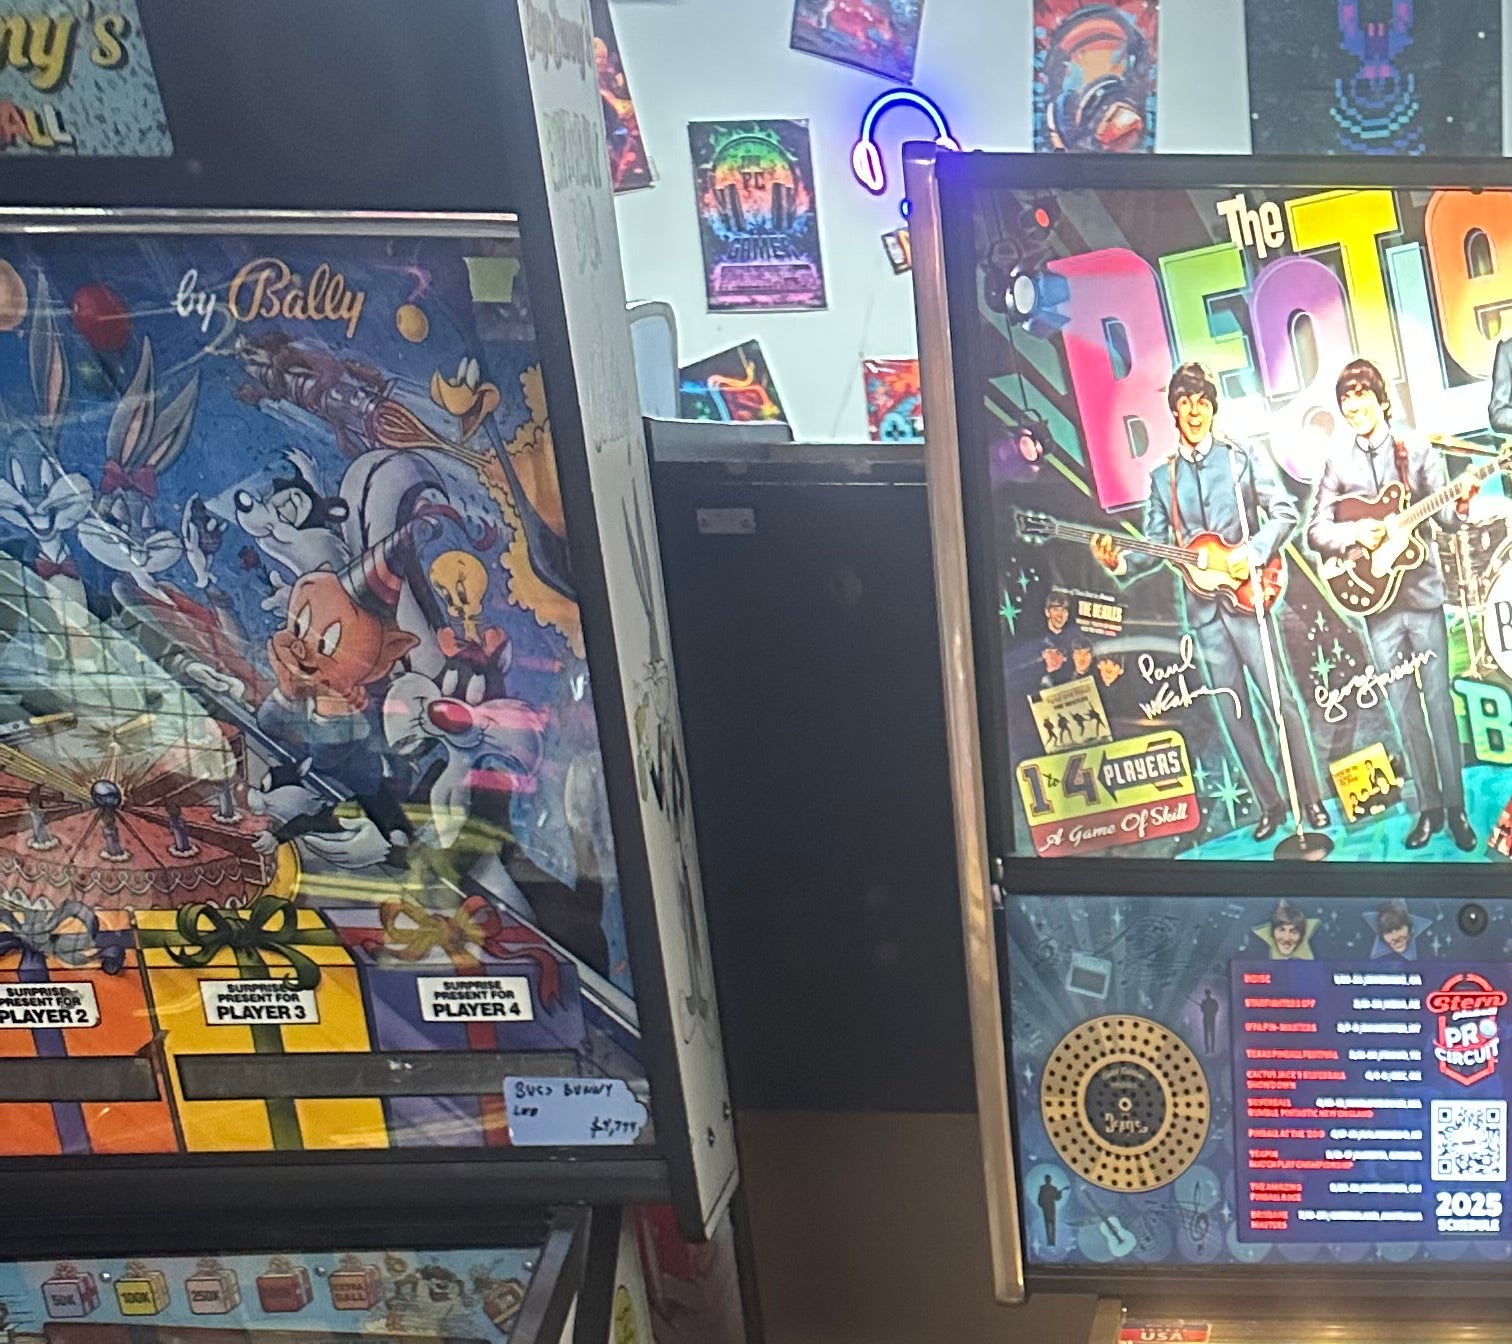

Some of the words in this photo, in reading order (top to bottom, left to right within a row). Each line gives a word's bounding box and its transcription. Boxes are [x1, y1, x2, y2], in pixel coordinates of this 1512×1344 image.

[1216, 193, 1285, 259] The
[174, 272, 217, 331] by
[227, 257, 367, 340] Bally
[1062, 753, 1100, 805] 4
[1103, 749, 1182, 787] PLAYERS
[1069, 821, 1116, 844] Game
[1121, 809, 1148, 838] Of
[1151, 802, 1190, 826] Skill
[443, 981, 502, 991] SURPRISE
[218, 993, 273, 1004] PRESENT
[275, 993, 300, 1004] FOR
[434, 990, 489, 1001] PRESENT
[491, 990, 516, 999] FOR
[0, 1010, 72, 1025] PLAYER
[76, 1009, 90, 1024] 2
[217, 1005, 292, 1020] PLAYER
[294, 1005, 307, 1020] 3
[432, 1002, 507, 1017] PLAYER
[509, 1002, 522, 1016] 4
[1433, 1036, 1501, 1066] CIRCUIT
[1435, 1192, 1503, 1218] 2025
[1139, 1331, 1184, 1342] USA
